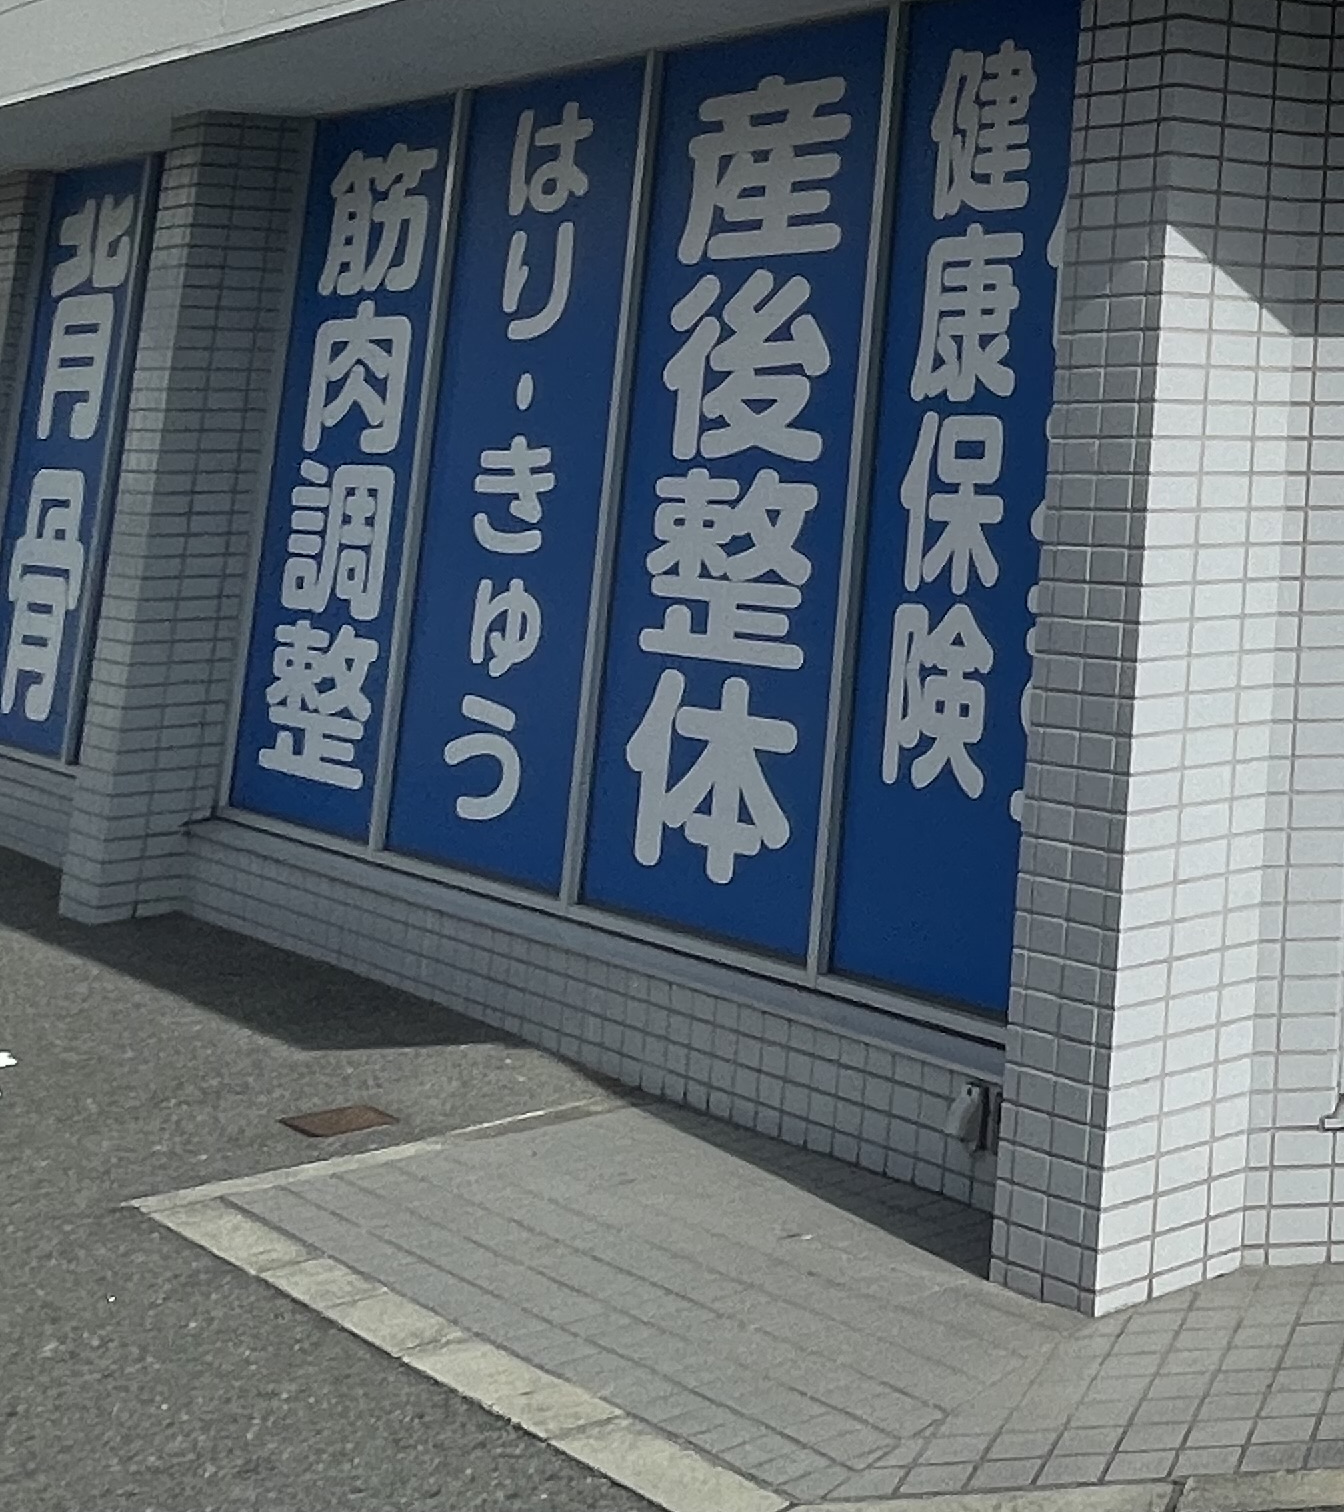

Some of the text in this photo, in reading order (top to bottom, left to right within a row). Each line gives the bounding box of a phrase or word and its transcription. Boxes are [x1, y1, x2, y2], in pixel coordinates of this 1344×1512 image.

[0, 194, 135, 723] 背骨
[258, 142, 440, 792] 筋肉調整
[444, 99, 593, 822] はり・きゅう
[626, 72, 853, 885] 産後整体
[880, 38, 1037, 800] 健康保険
